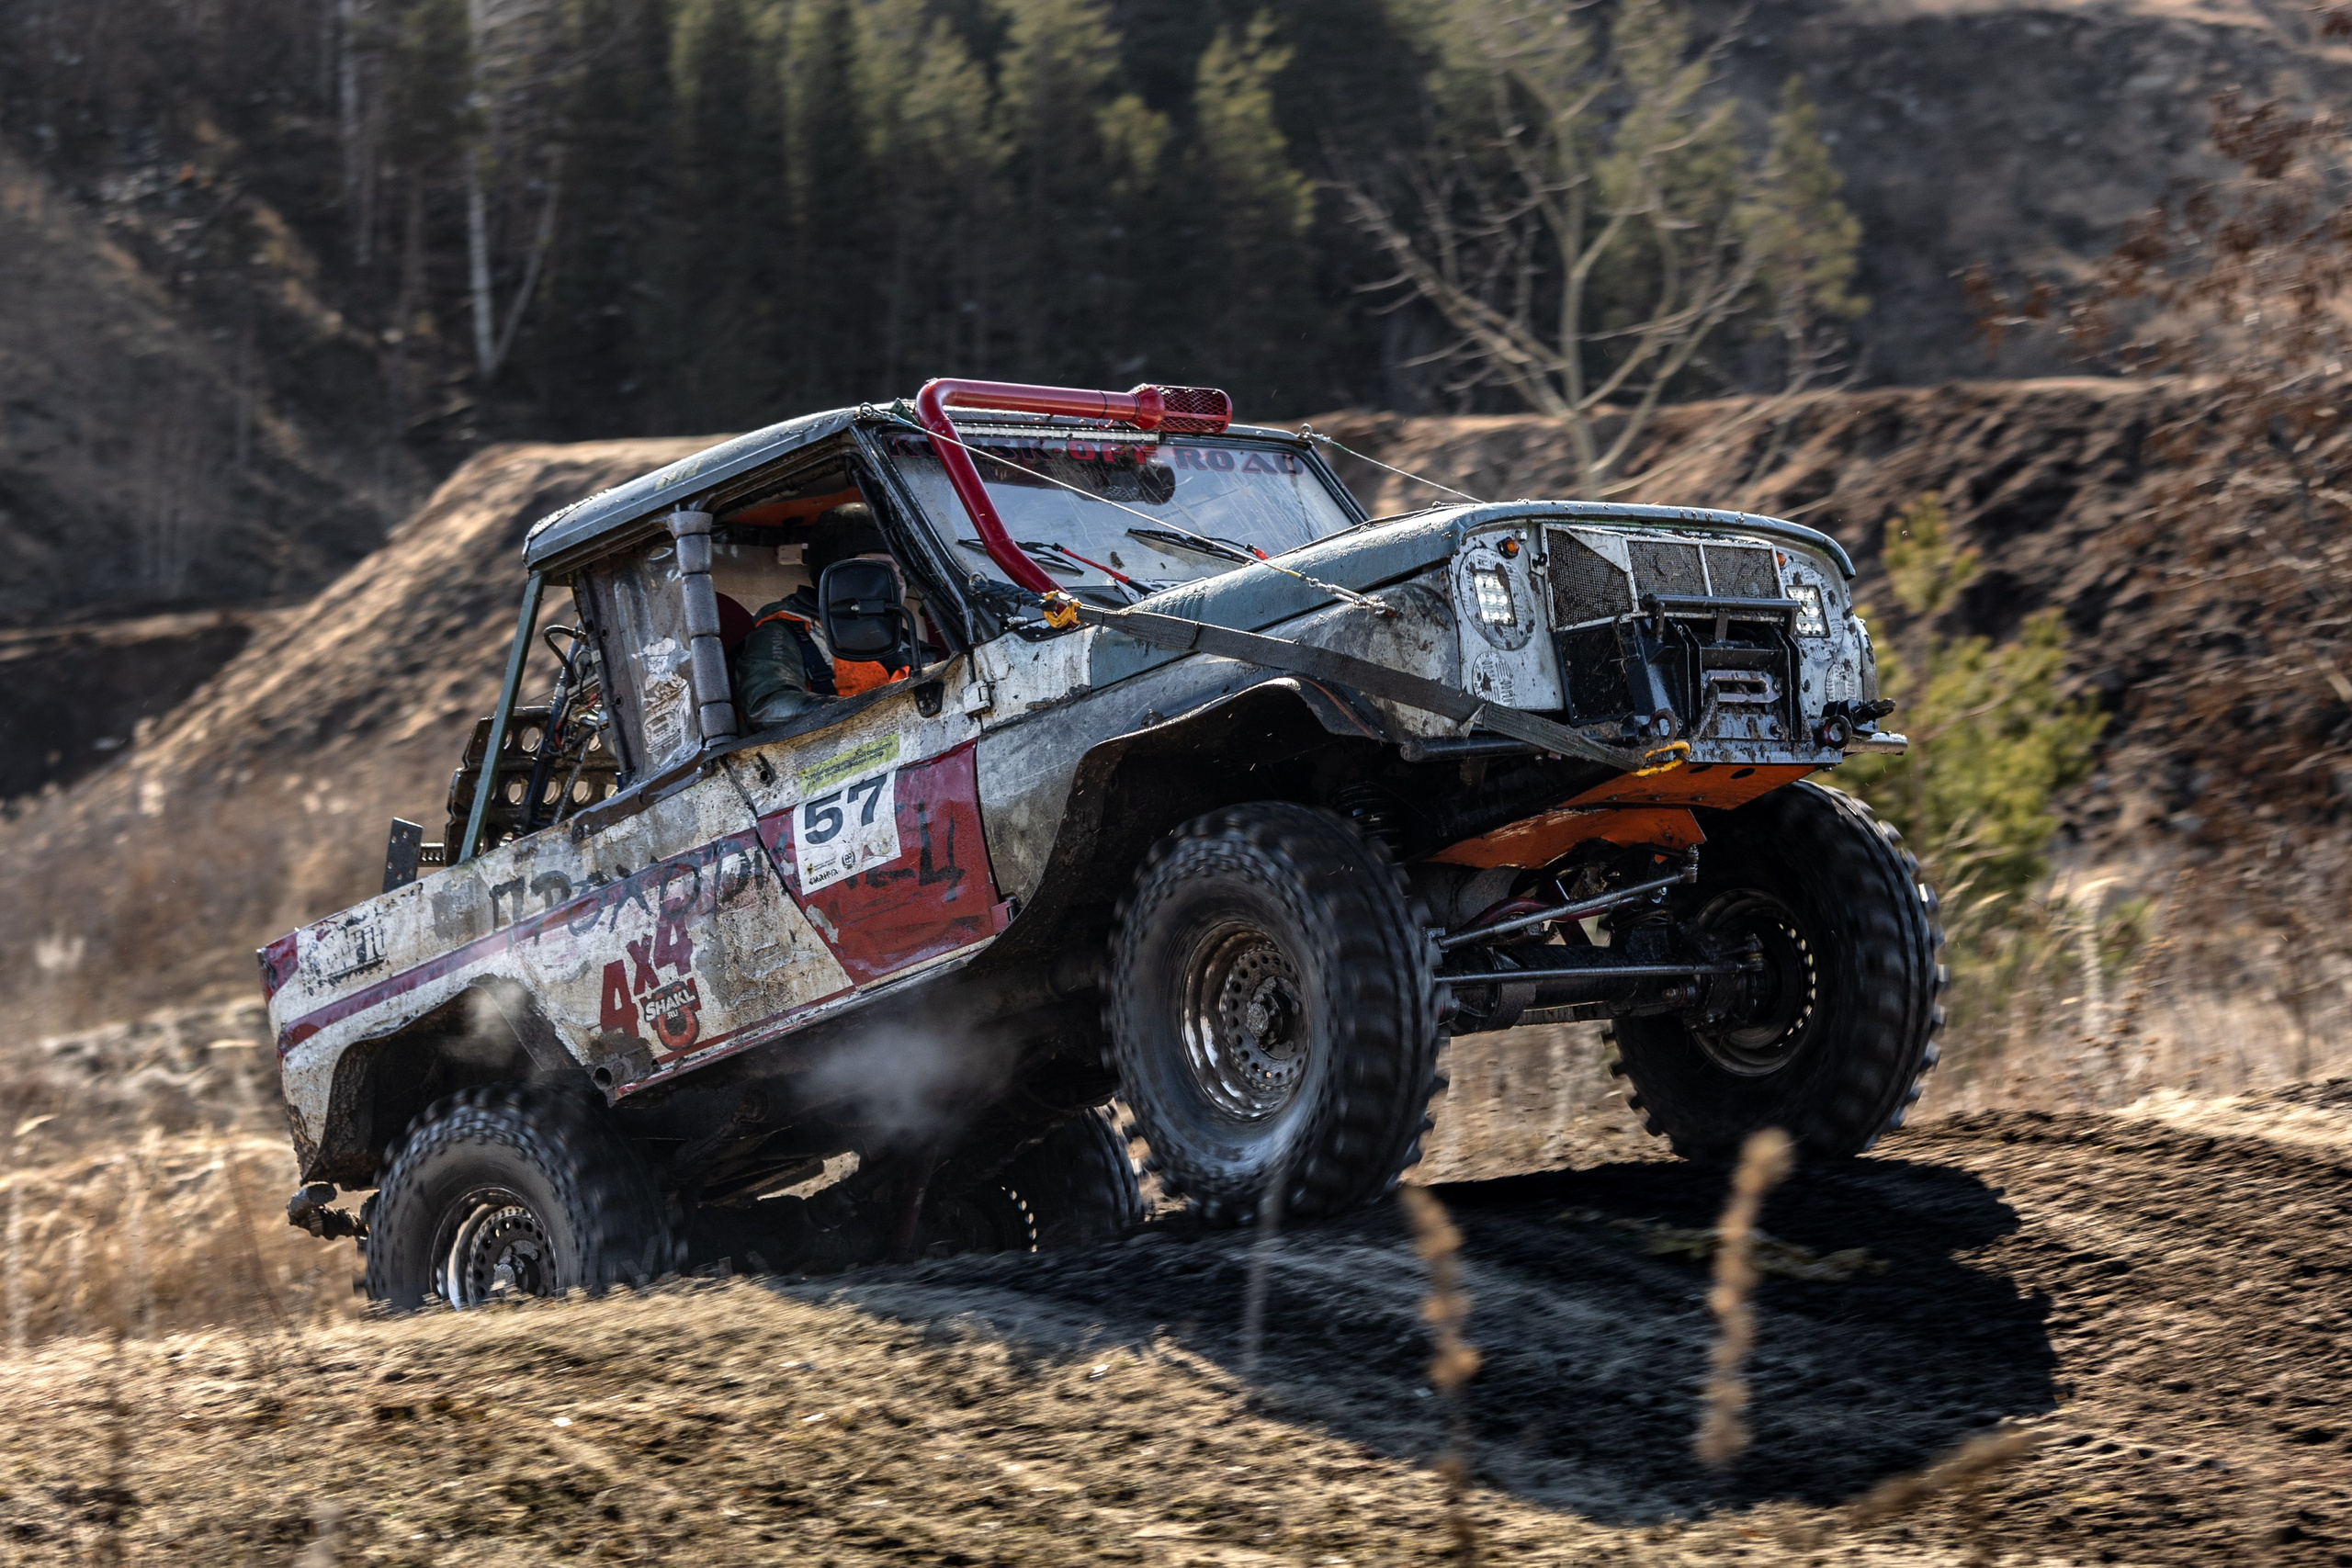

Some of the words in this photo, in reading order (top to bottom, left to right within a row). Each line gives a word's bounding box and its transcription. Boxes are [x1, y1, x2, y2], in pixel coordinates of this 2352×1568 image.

[1172, 447, 1306, 476] ROAD
[804, 772, 889, 845] 57
[645, 988, 697, 1022] SHAKL
